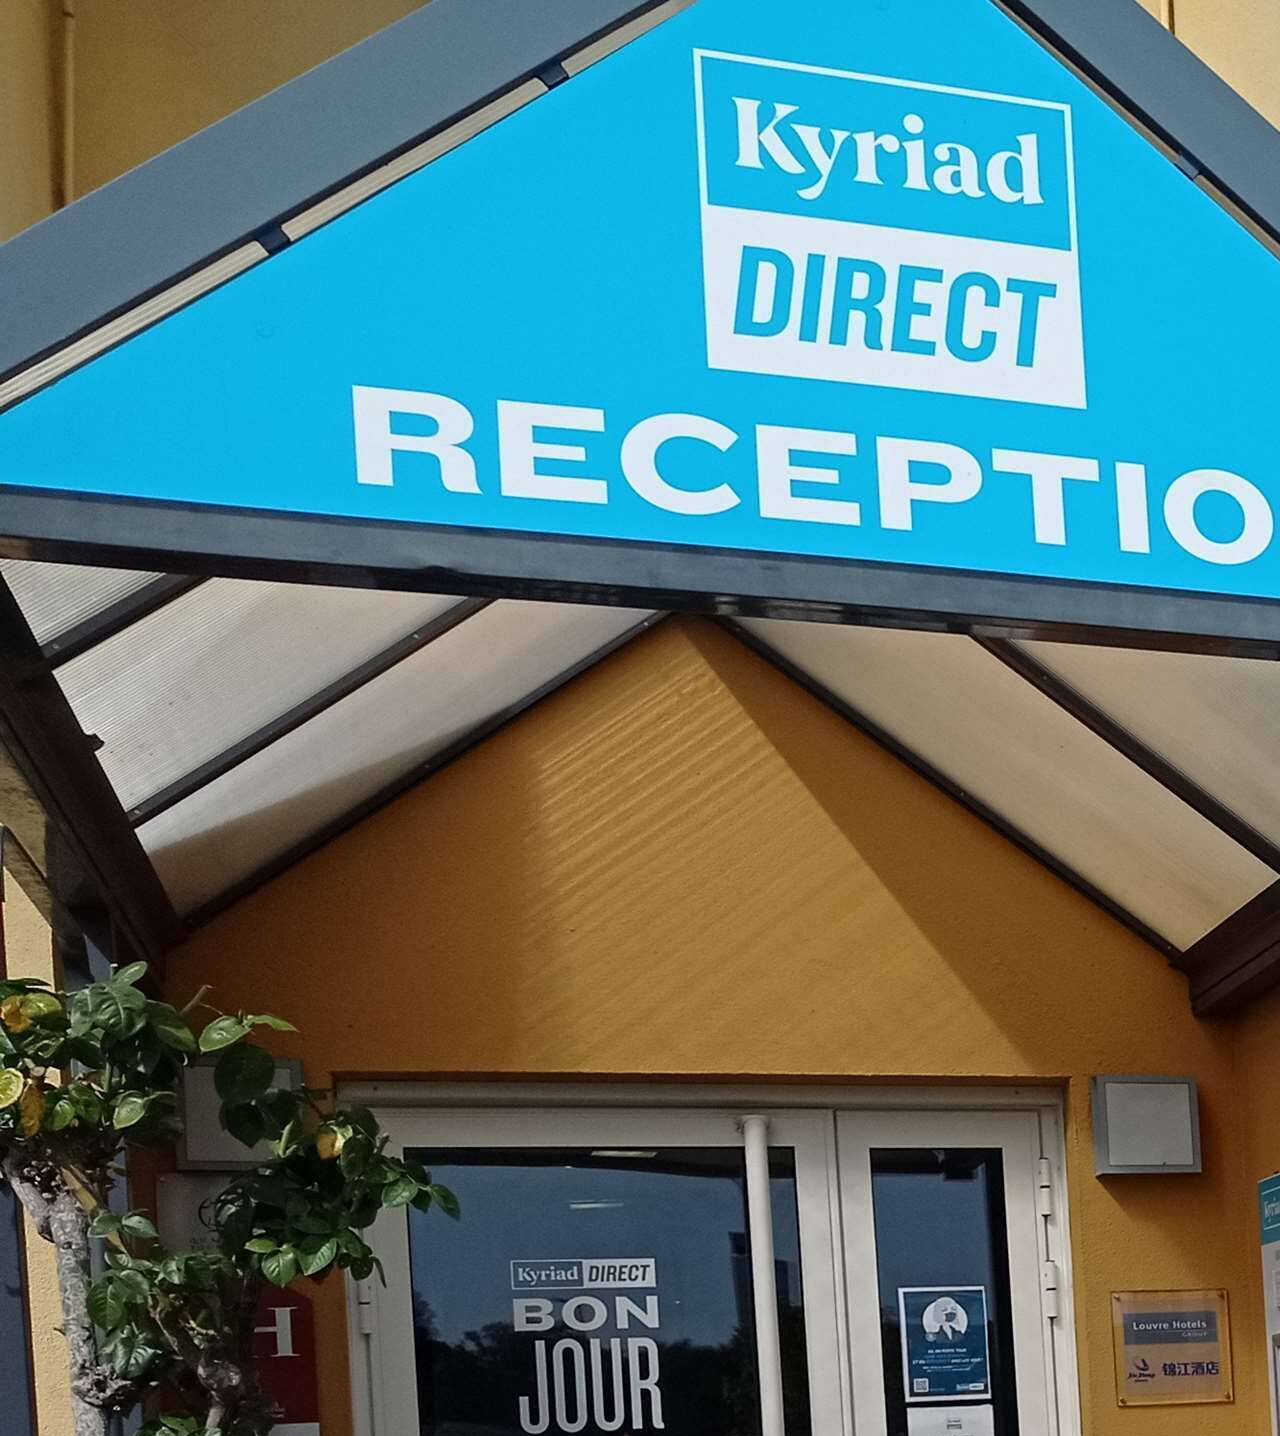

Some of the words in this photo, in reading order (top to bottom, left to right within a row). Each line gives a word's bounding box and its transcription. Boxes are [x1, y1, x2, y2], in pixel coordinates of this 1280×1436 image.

[733, 96, 1044, 205] Kyriad
[733, 245, 1056, 368] DIRECT
[517, 1265, 579, 1287] Kyriad
[588, 1264, 651, 1282] DIRECT
[512, 1295, 660, 1332] BON
[1132, 1320, 1170, 1331] Louvre
[1172, 1319, 1208, 1330] Hotels
[518, 1336, 665, 1434] JOUR
